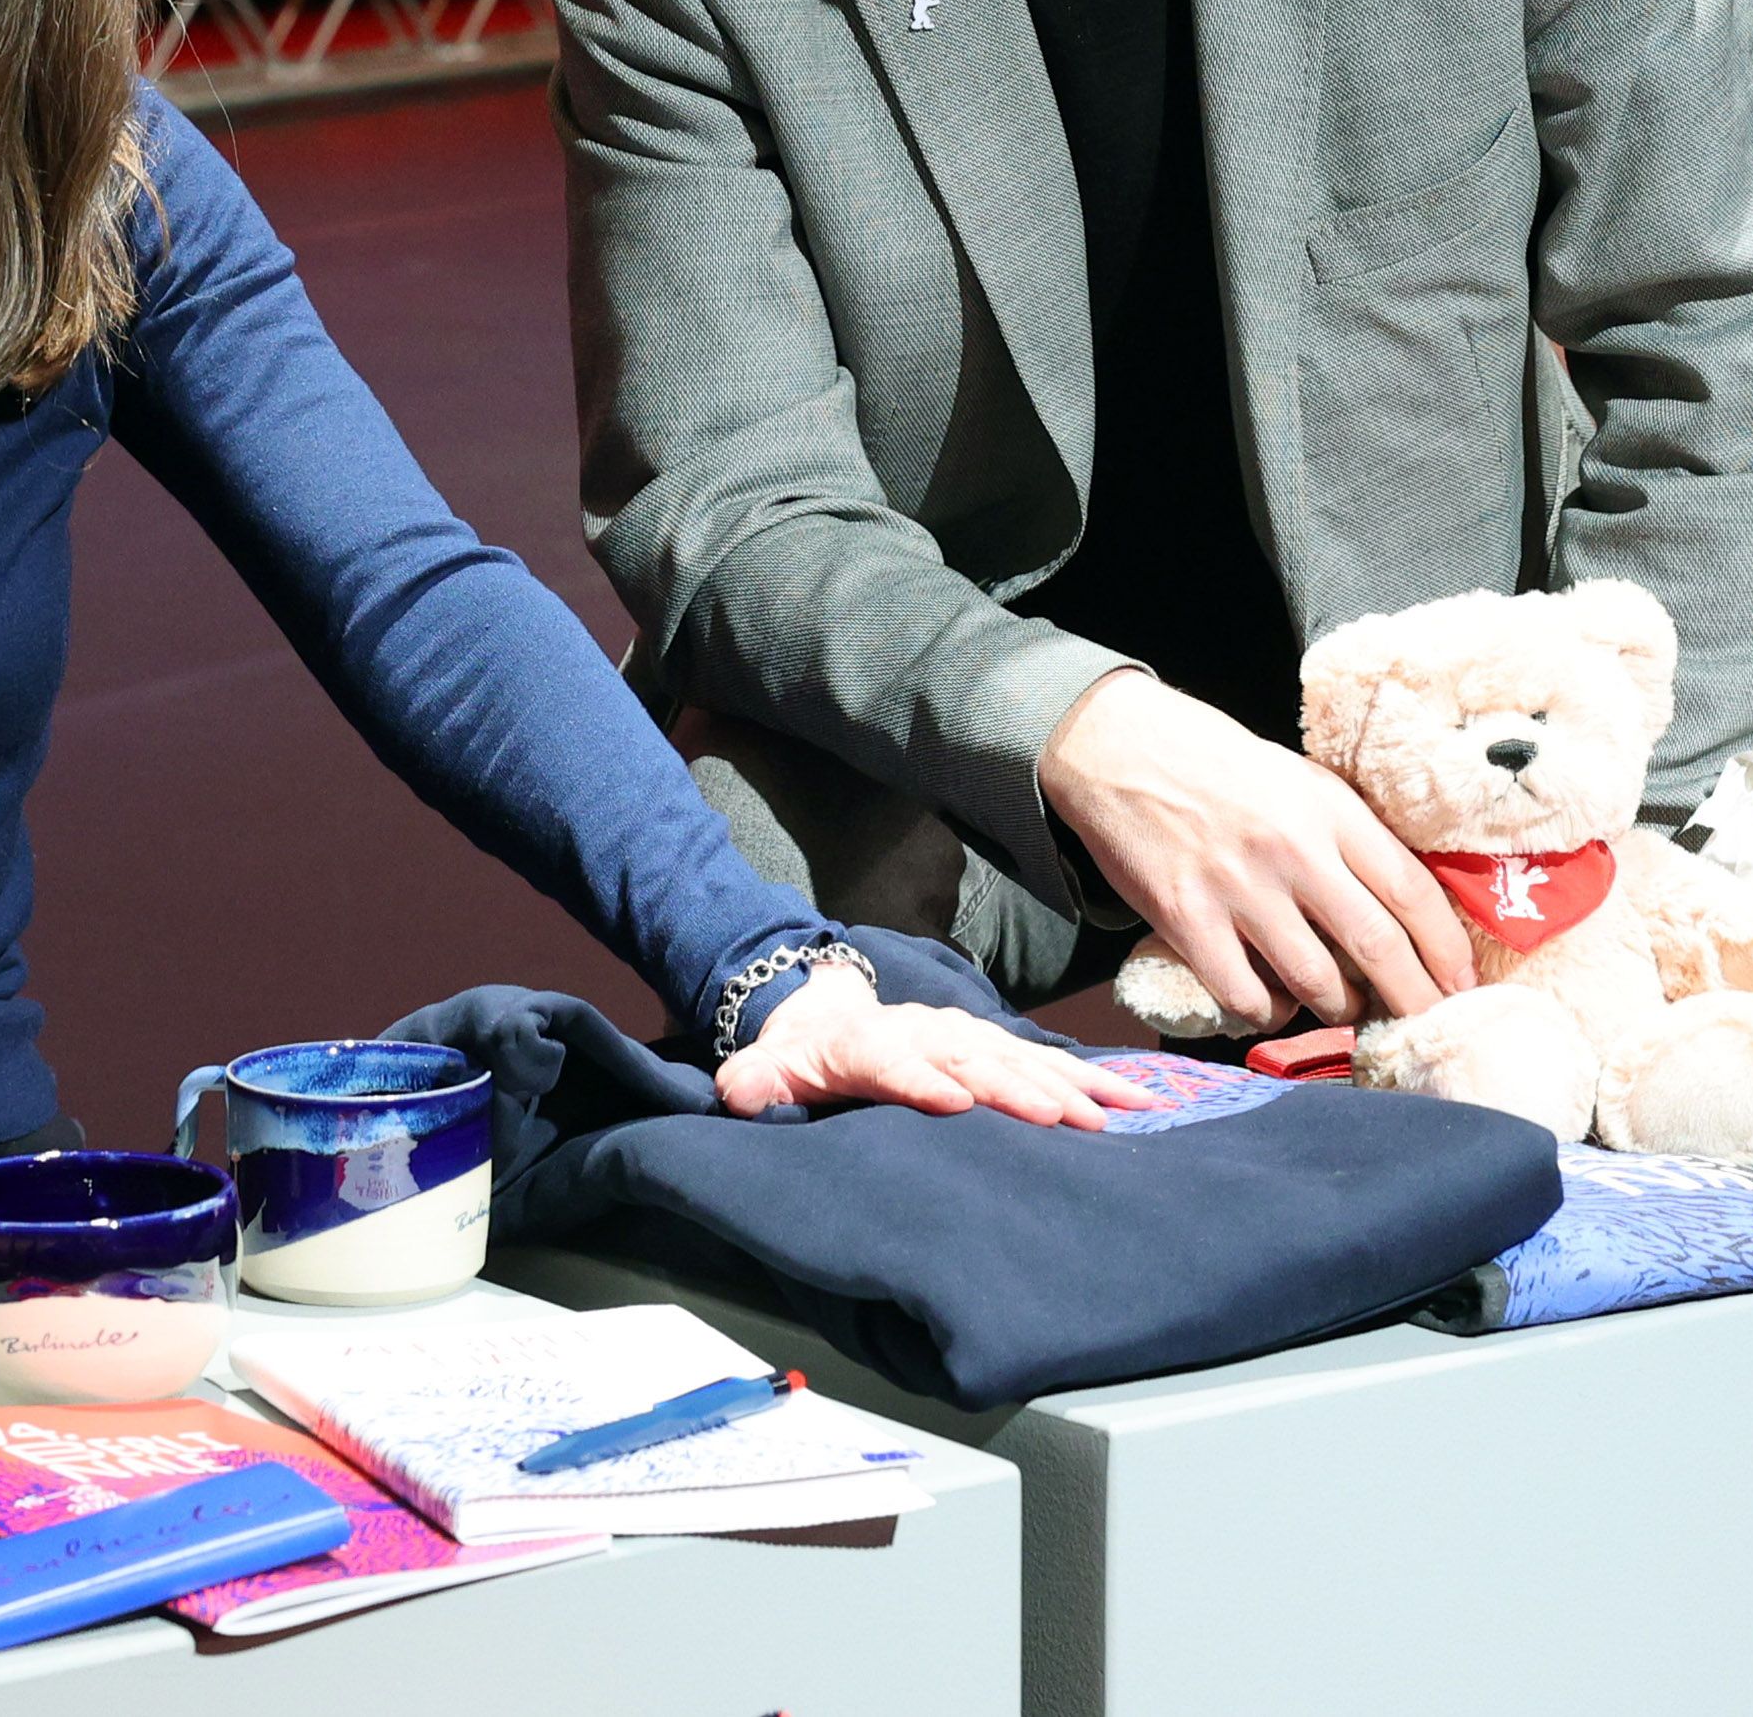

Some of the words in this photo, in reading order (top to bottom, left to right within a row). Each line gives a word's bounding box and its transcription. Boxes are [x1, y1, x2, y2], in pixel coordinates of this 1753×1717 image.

[0, 1331, 139, 1355] Berlinale
[3, 1430, 242, 1467] BERLI
[48, 1451, 235, 1484] NALE
